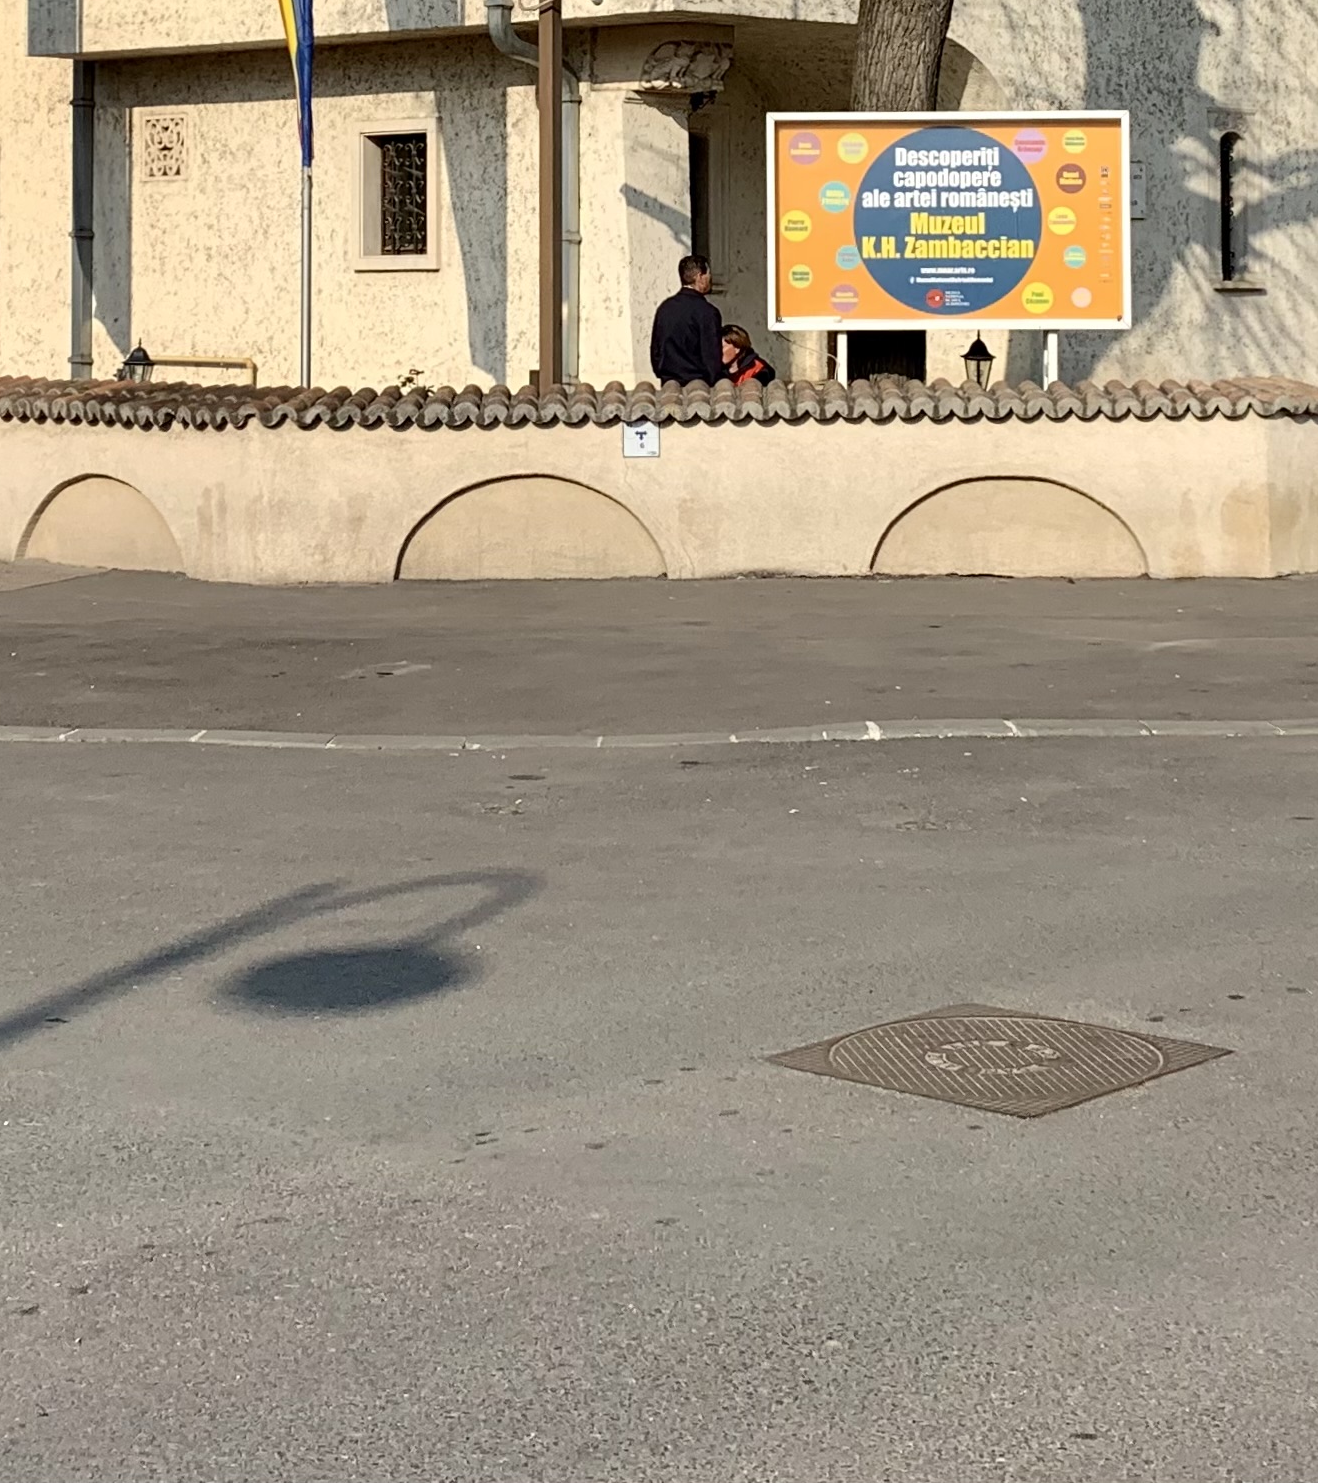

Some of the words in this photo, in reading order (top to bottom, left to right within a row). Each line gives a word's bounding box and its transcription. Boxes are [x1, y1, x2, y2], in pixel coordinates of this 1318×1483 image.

[895, 147, 999, 171] Descoperiți
[893, 169, 1002, 189] capodopere
[862, 189, 891, 208] ale
[894, 189, 937, 208] artei
[941, 188, 1034, 213] românești
[910, 212, 986, 235] Muzeul
[862, 236, 901, 259] K.H.
[904, 236, 1034, 259] Zambaccian
